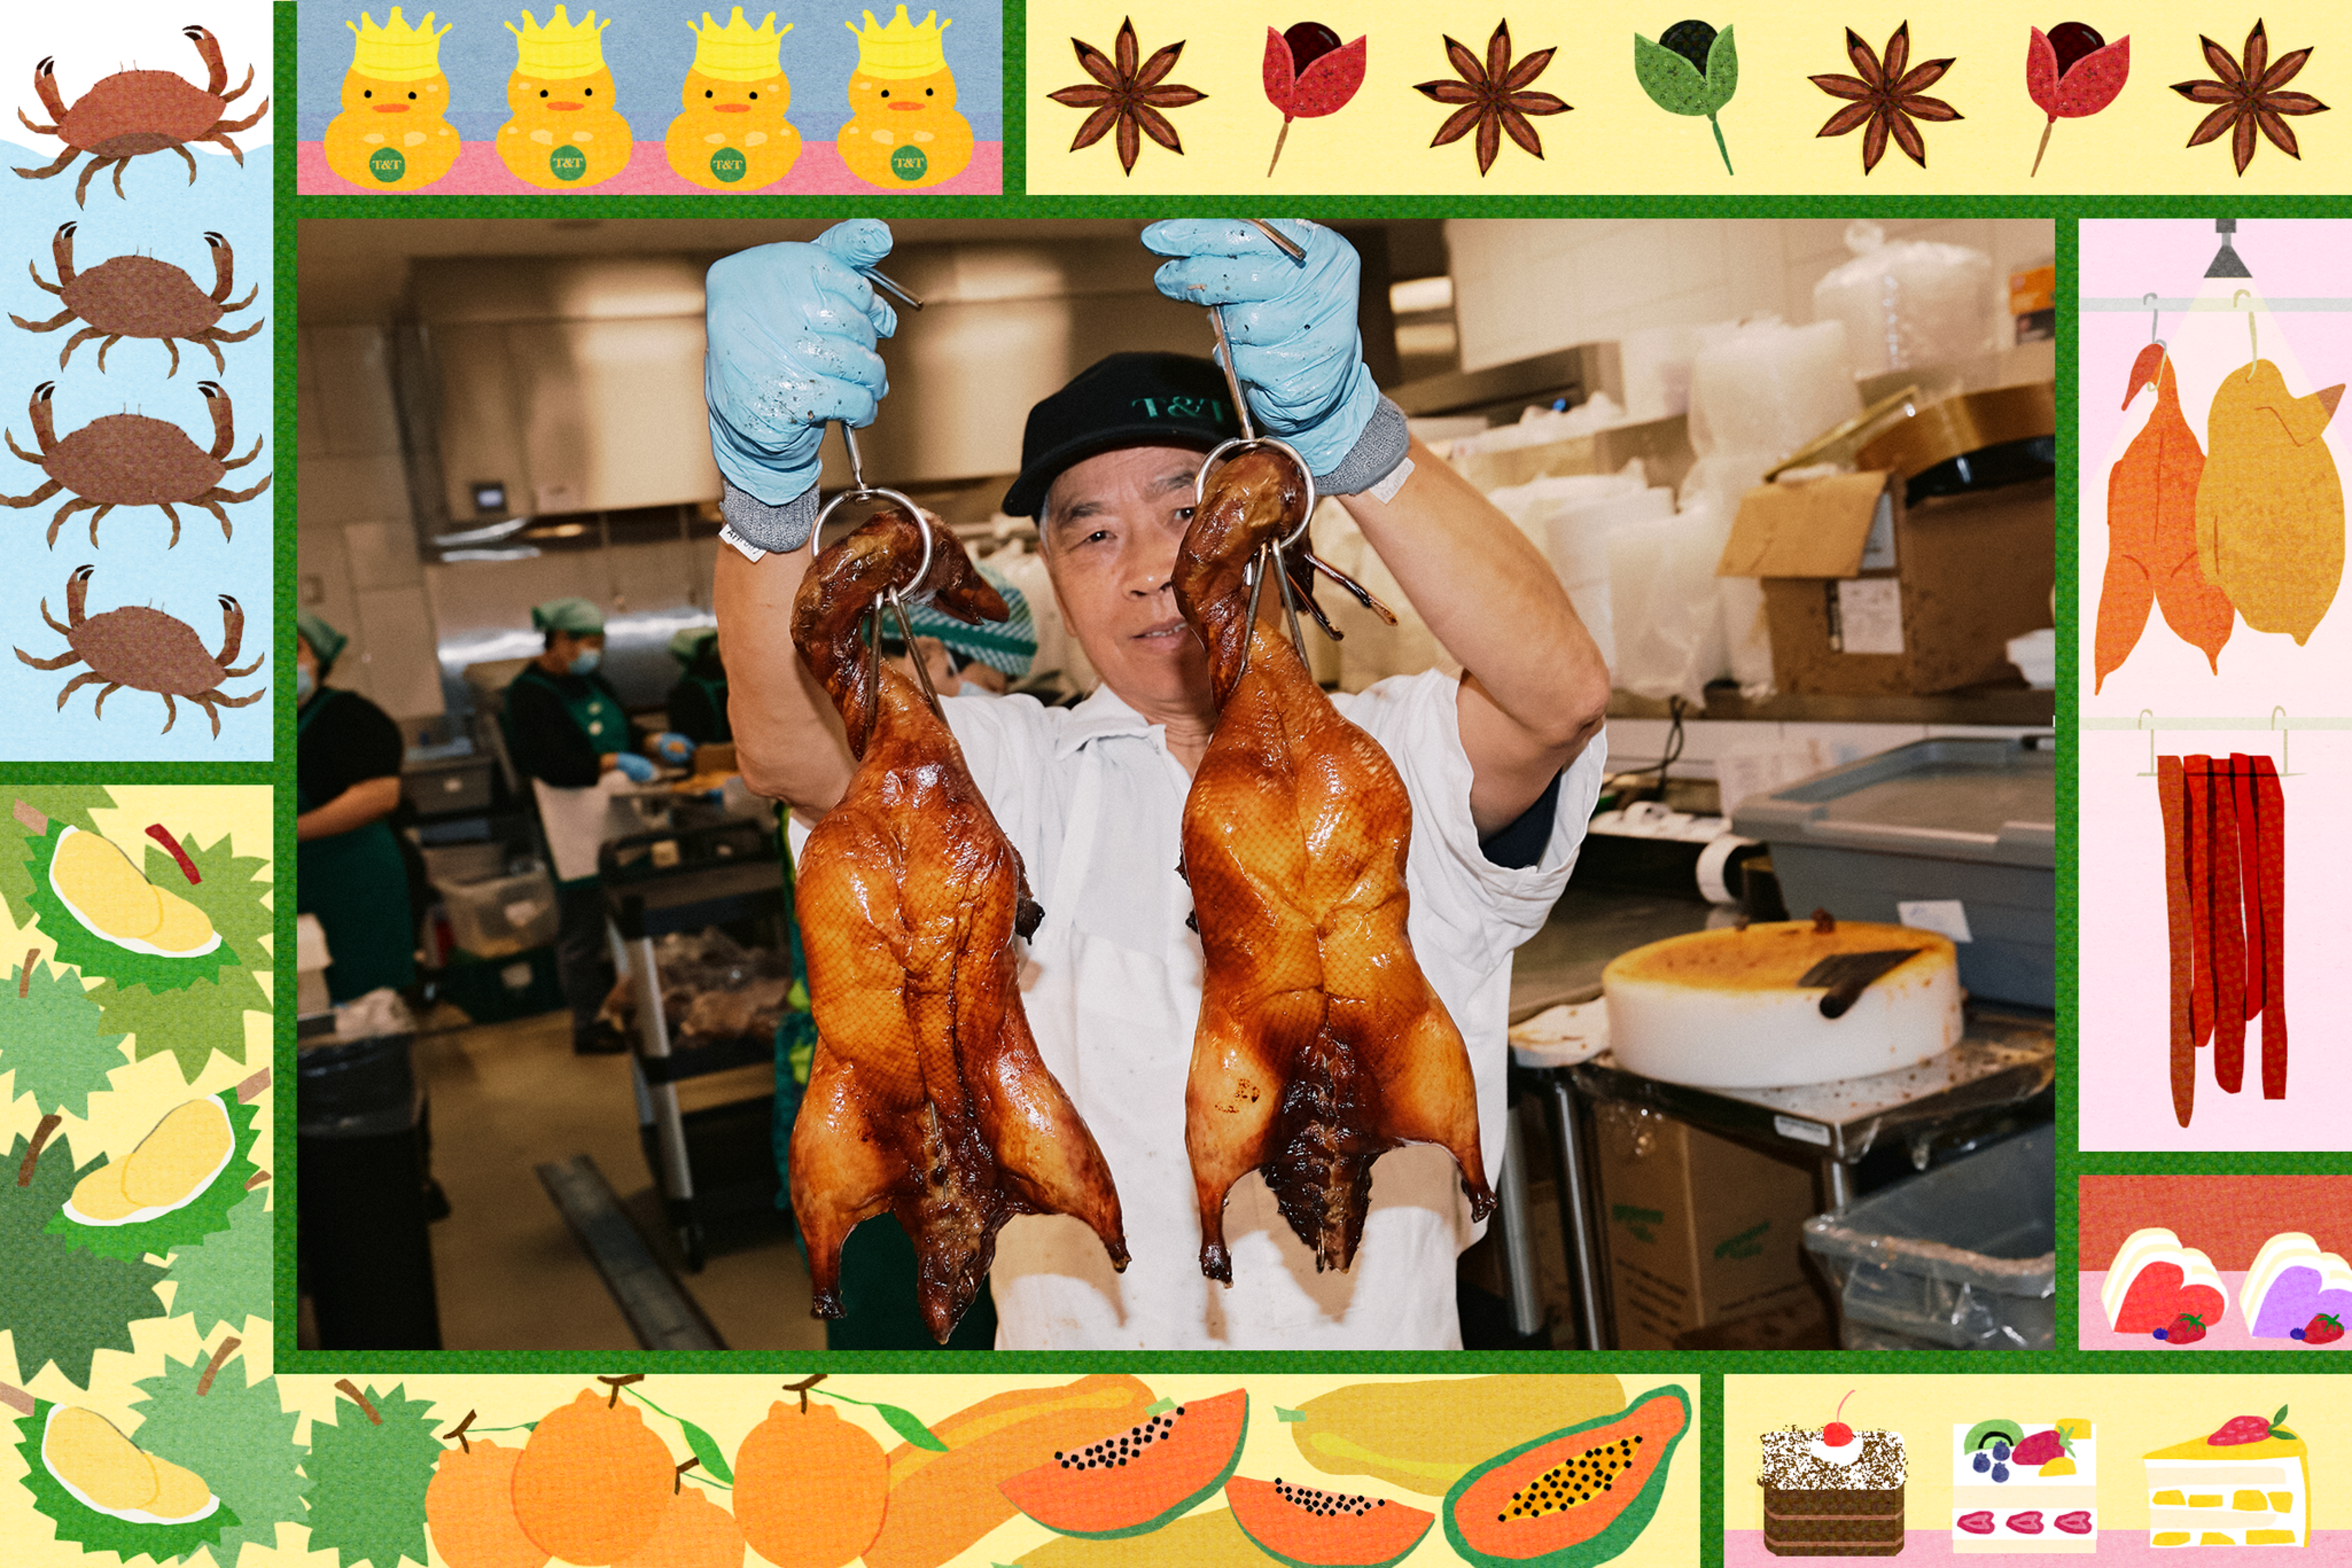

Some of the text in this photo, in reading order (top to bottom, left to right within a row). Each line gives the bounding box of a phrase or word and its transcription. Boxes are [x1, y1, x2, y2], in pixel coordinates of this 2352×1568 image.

[372, 160, 402, 170] T&T
[553, 157, 583, 168] T&T
[713, 160, 743, 170] T&T
[893, 157, 924, 168] T&T
[1131, 395, 1231, 423] T&T
